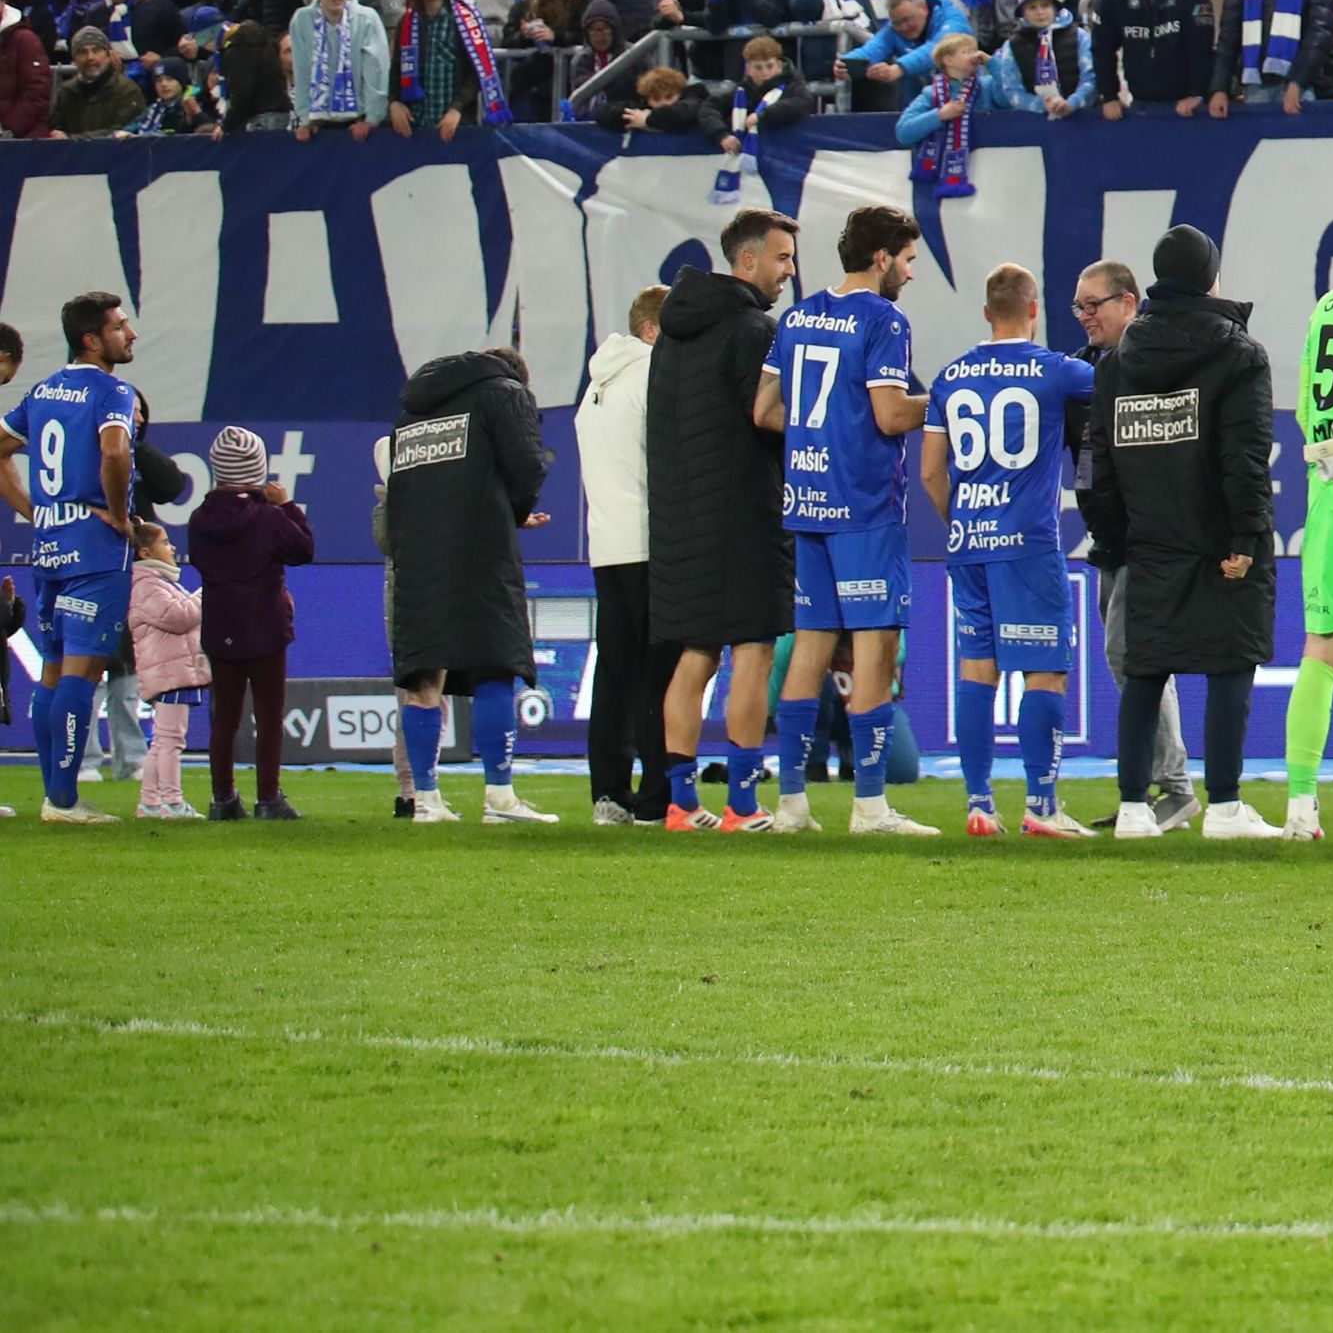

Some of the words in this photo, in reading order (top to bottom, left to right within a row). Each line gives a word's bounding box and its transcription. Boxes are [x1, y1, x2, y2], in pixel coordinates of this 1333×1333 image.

[785, 311, 858, 335] Oberbank
[943, 358, 1043, 383] Oberbank
[789, 344, 840, 430] 17
[1117, 390, 1197, 414] machsport
[944, 386, 1041, 472] 60
[1119, 414, 1194, 443] uhlsport
[40, 419, 66, 496] 9
[397, 435, 464, 467] uhlsport
[790, 445, 829, 473] PAŠIĆ
[798, 486, 828, 503] Linz
[797, 501, 850, 521] Airport
[967, 519, 998, 537] Linz
[968, 532, 1024, 552] Airport
[1001, 622, 1059, 639] LEEB
